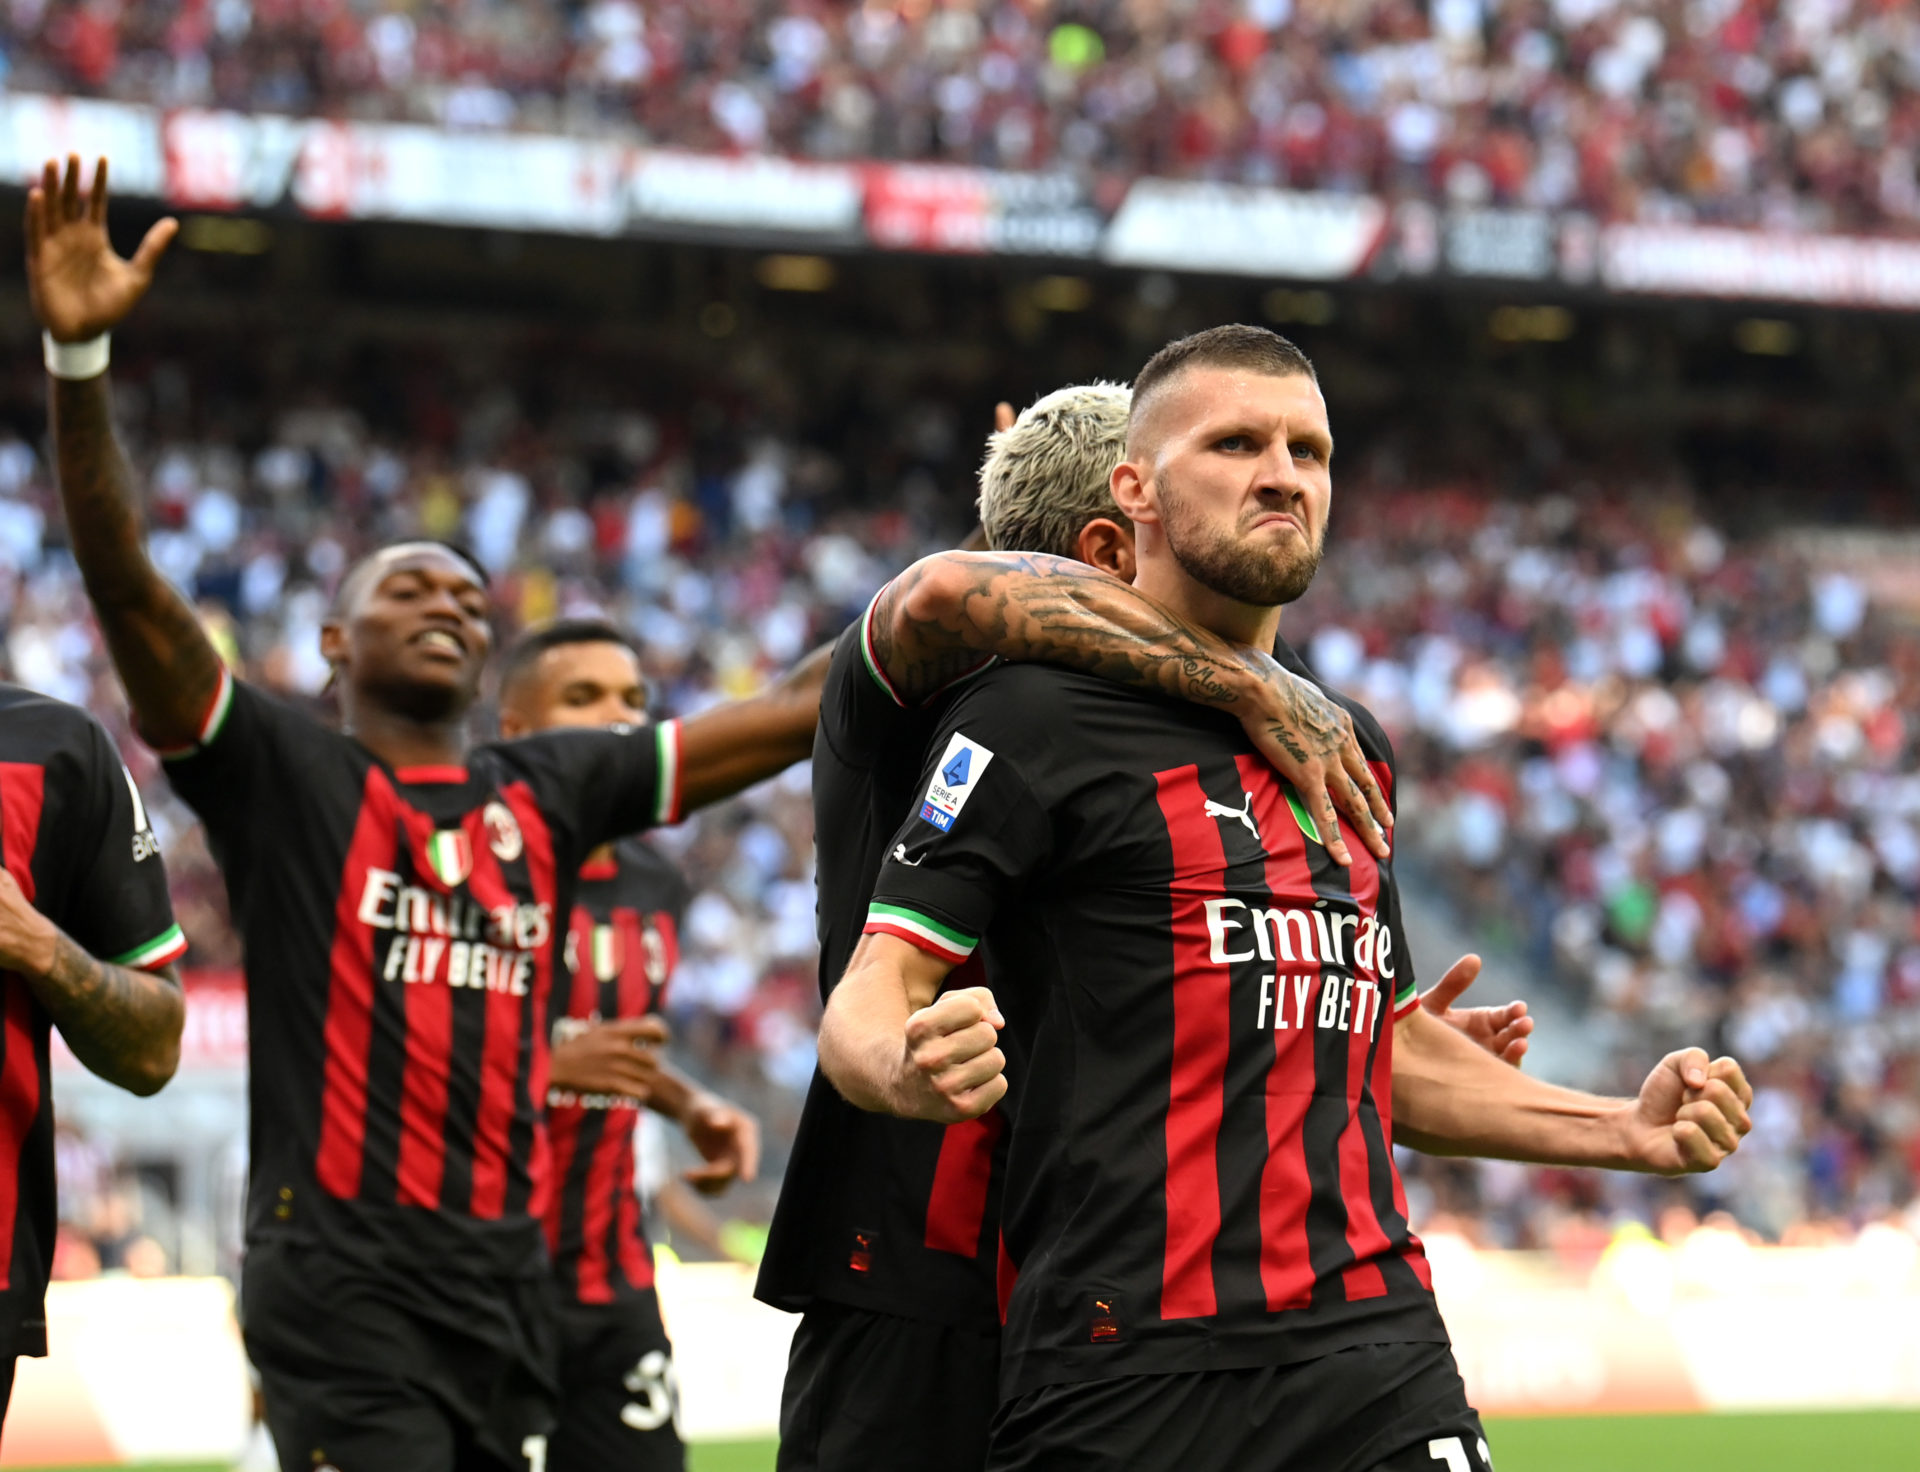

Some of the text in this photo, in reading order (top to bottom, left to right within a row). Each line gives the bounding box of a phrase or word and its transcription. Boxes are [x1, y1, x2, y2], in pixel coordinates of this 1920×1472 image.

[931, 809, 950, 828] TIM
[932, 784, 958, 806] SERIE A
[358, 866, 552, 949] Emiraes
[383, 934, 446, 984] FLY
[1257, 975, 1311, 1029] FLY
